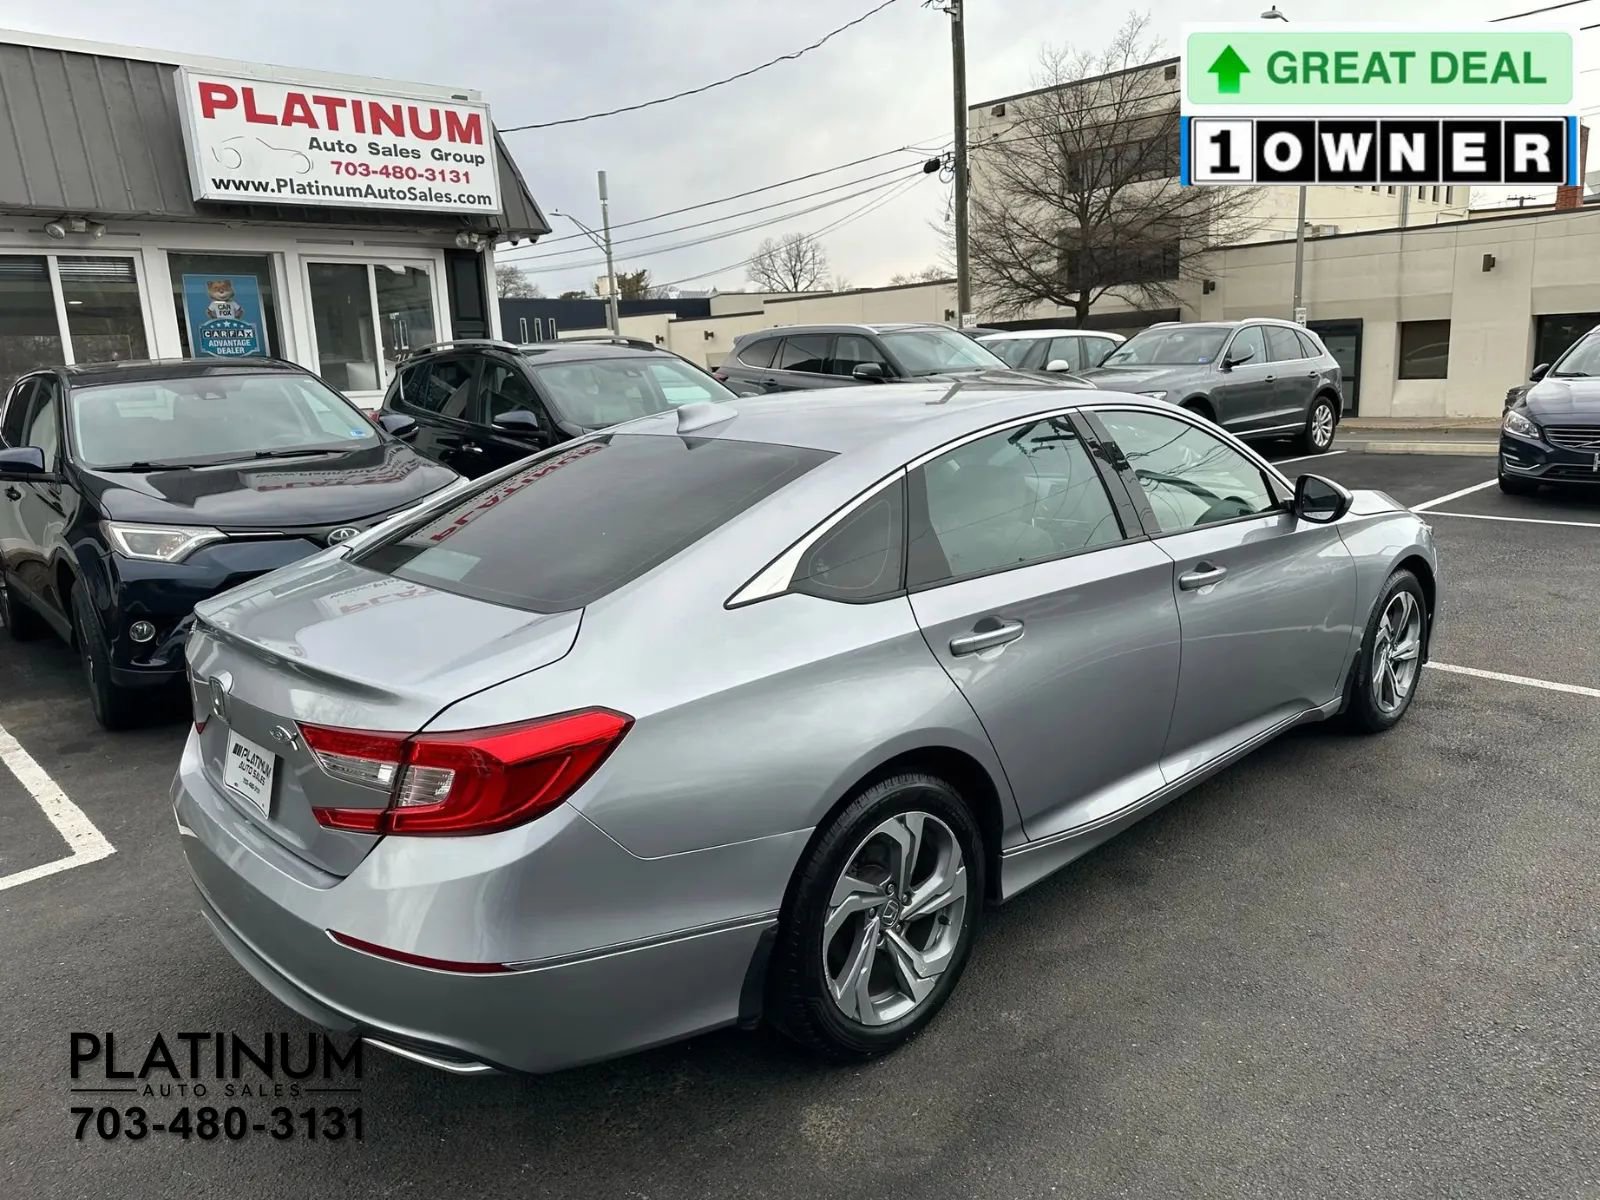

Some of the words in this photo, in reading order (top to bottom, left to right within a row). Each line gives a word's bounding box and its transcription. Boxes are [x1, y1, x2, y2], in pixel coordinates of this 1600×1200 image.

[198, 81, 483, 145] PLATINUM
[308, 136, 357, 154] Auto
[368, 142, 421, 160] Sales
[431, 148, 486, 167] Group
[330, 160, 471, 185] 703-480-3131
[211, 177, 492, 206] www.PlatinumAutoSales.com
[204, 330, 253, 338] CARFAX
[208, 339, 251, 347] ADVANTAGE
